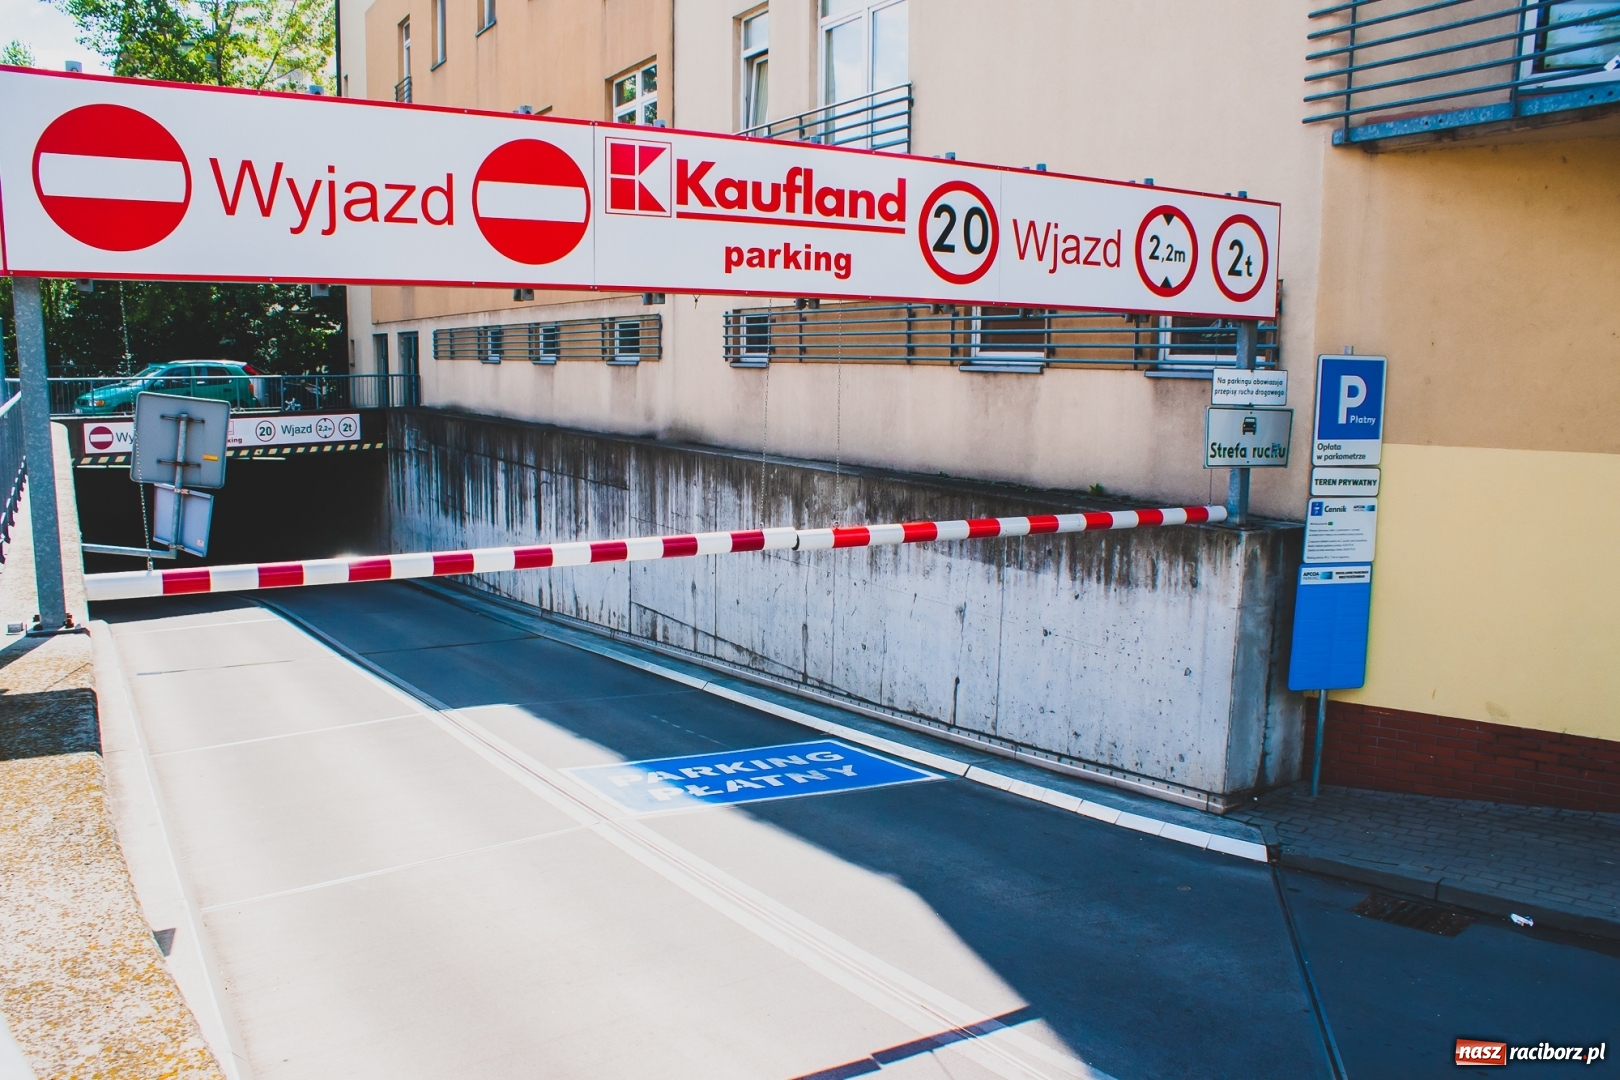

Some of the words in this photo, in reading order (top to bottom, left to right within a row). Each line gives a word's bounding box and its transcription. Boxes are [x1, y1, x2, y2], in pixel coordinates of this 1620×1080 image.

[209, 157, 455, 237] Wyjazd
[676, 159, 906, 222] Kaufland
[932, 204, 989, 255] 20
[1013, 219, 1121, 275] Wjazd
[1148, 234, 1186, 263] 2,2m
[724, 243, 852, 280] parking
[1227, 239, 1253, 278] 2t
[1227, 377, 1252, 387] parkingu
[1214, 387, 1237, 397] przepisy
[1238, 387, 1254, 396] ruchu
[1255, 388, 1285, 398] drogowego
[1337, 374, 1368, 425] P
[342, 422, 353, 433] 2t
[1350, 415, 1377, 426] Płatny
[259, 426, 273, 437] 20
[281, 423, 313, 437] Wjazd
[115, 432, 134, 445] Wy
[1209, 442, 1248, 459] Strefa
[1252, 442, 1286, 459] ruchu
[1317, 443, 1342, 452] Opłata
[1323, 452, 1366, 462] parkometrze
[1314, 478, 1337, 486] TEREN
[1338, 478, 1377, 487] PRYWATNY
[1324, 505, 1347, 513] Cennik
[608, 750, 845, 788] PARKING
[647, 764, 857, 803] PŁATNY
